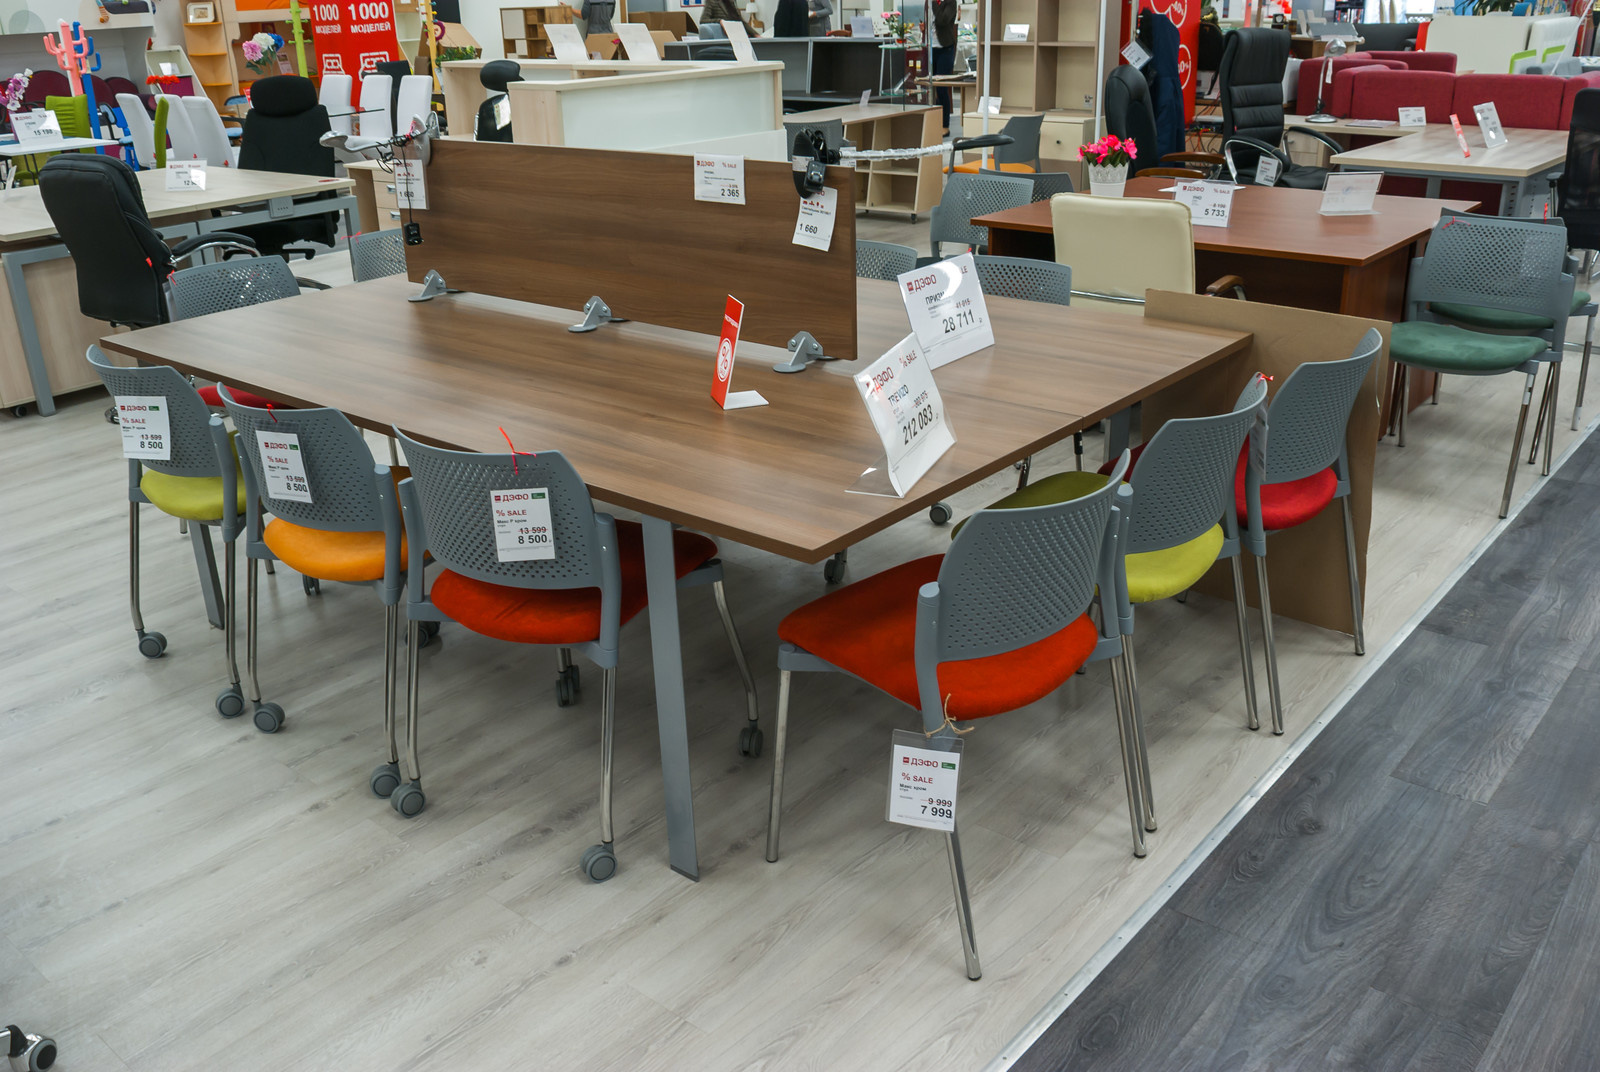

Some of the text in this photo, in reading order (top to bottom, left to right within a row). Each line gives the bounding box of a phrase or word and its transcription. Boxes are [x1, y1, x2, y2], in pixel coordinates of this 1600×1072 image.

[313, 4, 339, 21] 1000
[315, 24, 341, 34] МОДЕЛЕЙ
[350, 21, 392, 33] МОДЕЛЕЙ
[721, 188, 740, 198] 2 365
[1204, 208, 1225, 217] 5 733
[805, 224, 818, 234] 660
[914, 274, 937, 292] ДЭФО
[943, 316, 956, 334] 28
[957, 309, 975, 328] 711
[906, 350, 917, 365] SALE
[871, 366, 894, 394] ДЭФО
[903, 416, 919, 446] 212
[918, 404, 933, 431] 083
[140, 440, 164, 450] 8 500
[269, 442, 288, 450] ДЭФО
[286, 482, 308, 493] 8 500
[502, 493, 529, 503] ДЭФО
[519, 527, 530, 535] 13
[531, 526, 547, 534] 599
[518, 534, 548, 545] 8 500
[911, 757, 939, 768] ДЭФО
[912, 775, 934, 784] SALE
[928, 797, 953, 808] 9 999
[920, 804, 928, 815] 7
[931, 806, 953, 819] 999
